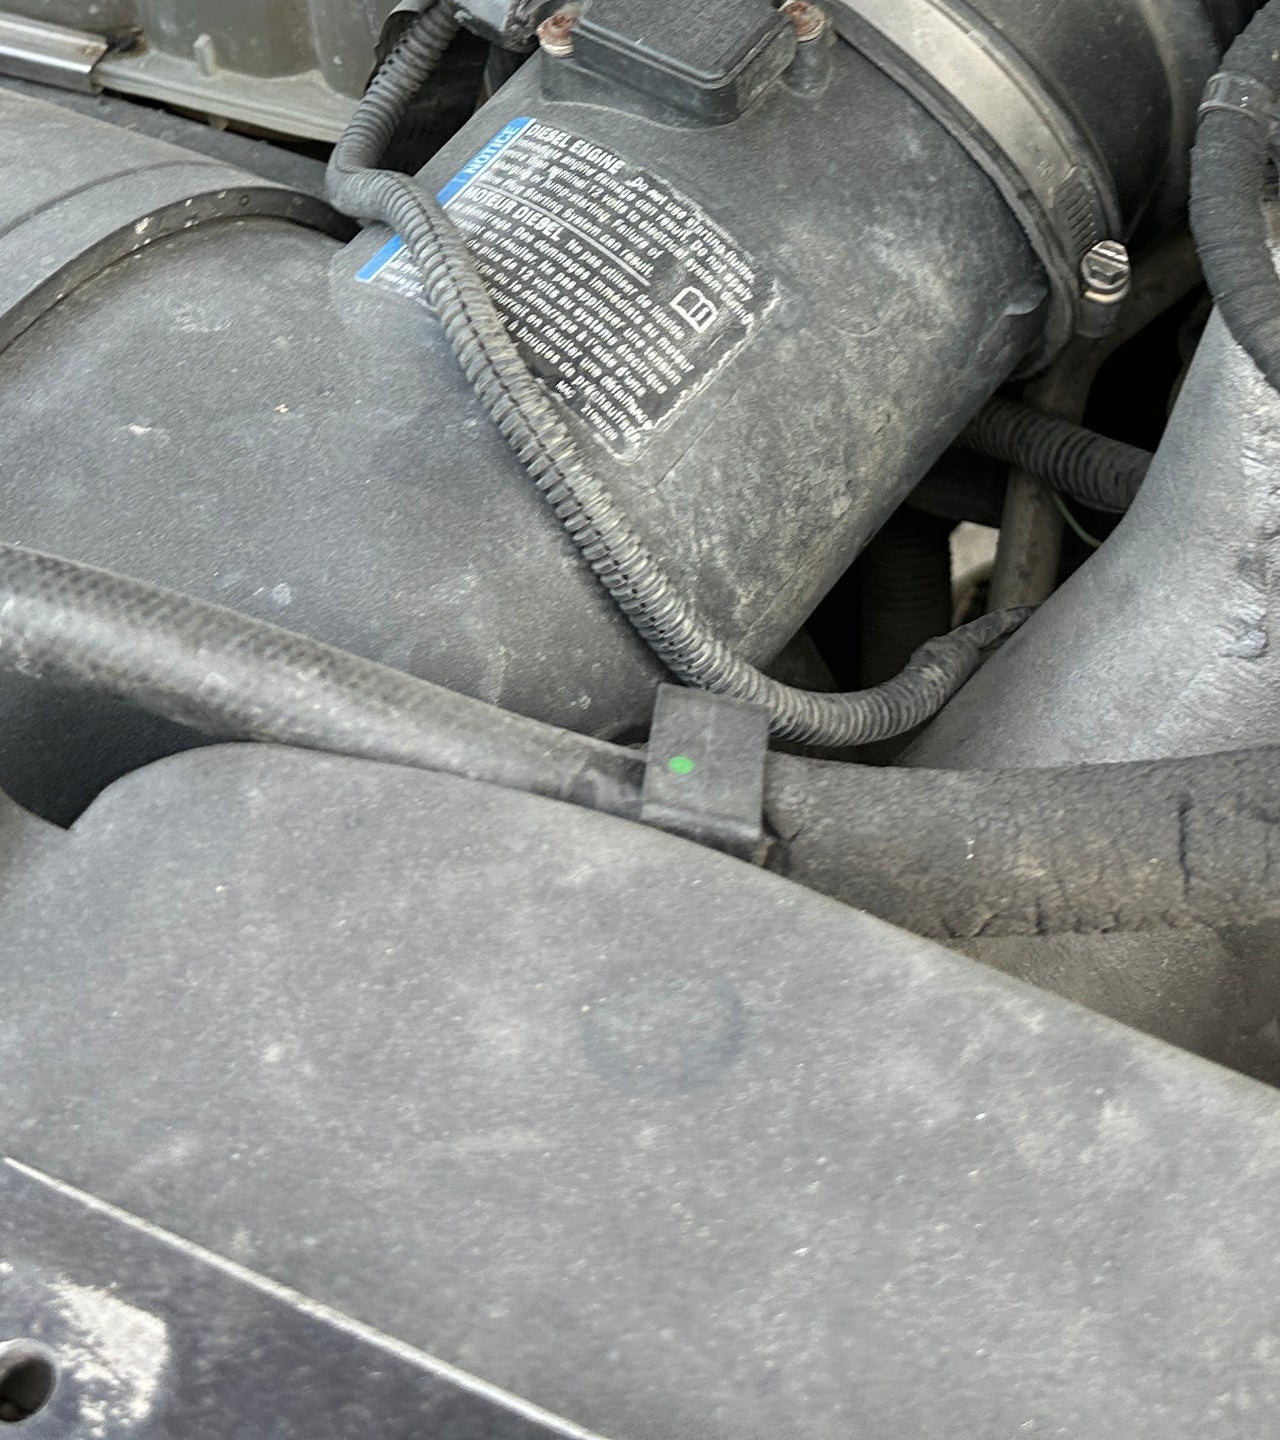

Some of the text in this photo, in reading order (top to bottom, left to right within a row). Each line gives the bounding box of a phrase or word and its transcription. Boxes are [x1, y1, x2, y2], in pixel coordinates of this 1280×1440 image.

[469, 125, 519, 175] NOTICE
[526, 123, 573, 146] DIESEL
[568, 140, 623, 173] ENGINE
[630, 176, 650, 192] Do
[664, 202, 688, 220] use
[461, 185, 519, 214] MOTEUR
[512, 205, 567, 241] DIESEL
[563, 238, 584, 255] Ne
[577, 250, 604, 269] pas
[598, 263, 639, 296] utiliser
[634, 293, 654, 309] de
[522, 186, 565, 214] Starting
[560, 207, 602, 237] System
[598, 233, 623, 251] can
[586, 184, 605, 198] 12
[600, 193, 629, 214] volts
[625, 209, 641, 223] to
[637, 219, 689, 260] electrical
[593, 171, 638, 202] damage
[633, 198, 659, 217] can
[688, 239, 709, 257] Do
[610, 218, 650, 250] Failure
[645, 245, 665, 260] of
[476, 244, 504, 263] plus
[500, 256, 519, 271] de
[515, 265, 535, 281] 12
[530, 276, 561, 299] volts
[556, 295, 576, 310] au
[481, 229, 499, 242] en
[535, 259, 557, 276] Ne
[551, 272, 577, 290] pas
[571, 287, 627, 330] appliquer
[621, 327, 647, 349] une
[642, 346, 683, 385] tension
[492, 272, 510, 285] ou
[507, 279, 523, 293] le
[518, 287, 579, 335] démarrage
[511, 226, 536, 244] Des
[532, 238, 592, 281] dommages
[640, 321, 661, 338] au
[654, 336, 695, 373] moteur
[505, 318, 521, 331] à
[514, 326, 561, 364] bougies
[557, 360, 577, 377] de
[524, 313, 544, 328] en
[539, 323, 583, 360] résulter
[577, 356, 604, 378] une
